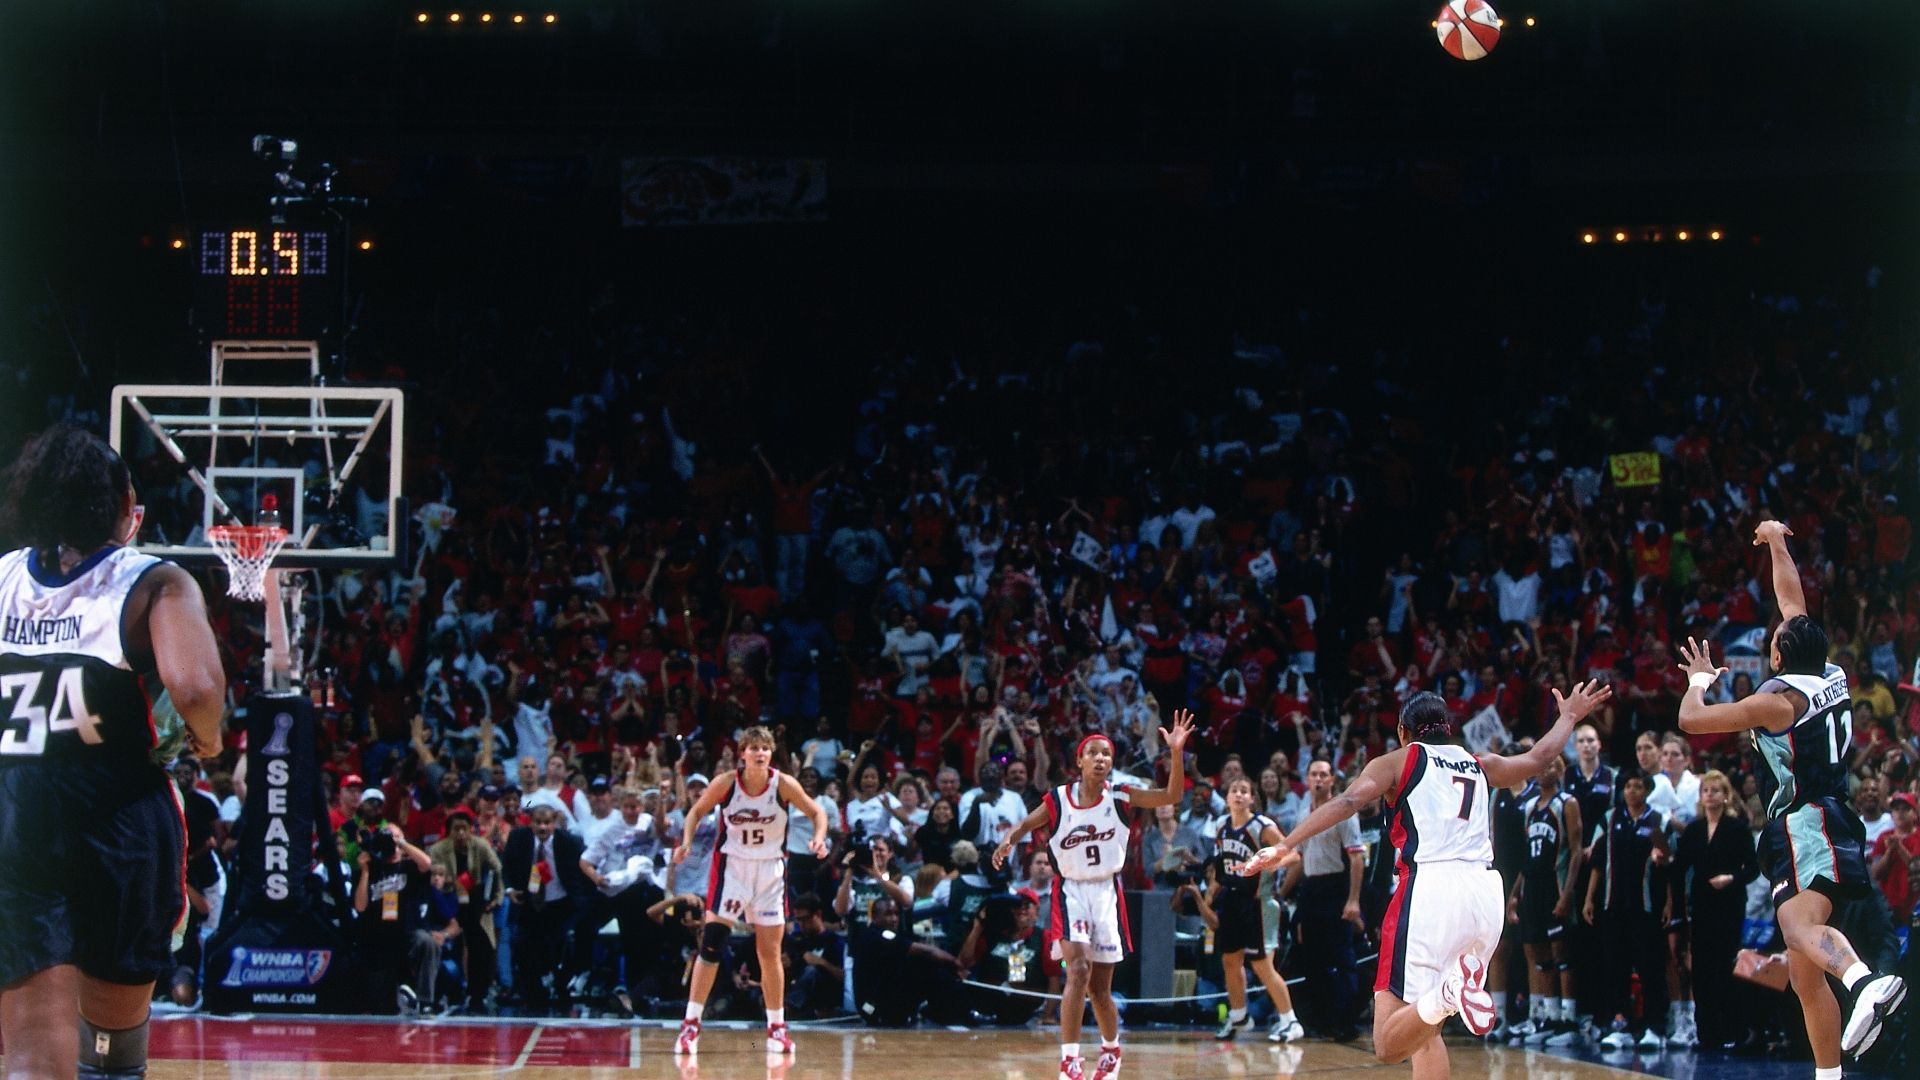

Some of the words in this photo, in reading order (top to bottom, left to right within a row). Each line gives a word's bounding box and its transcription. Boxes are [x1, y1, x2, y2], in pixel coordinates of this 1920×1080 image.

[2, 615, 83, 646] HAMPTON
[0, 667, 104, 755] 34
[1825, 710, 1852, 764] 11
[1452, 776, 1476, 821] 7
[264, 758, 290, 900] SEARS
[742, 829, 764, 845] 15
[1086, 845, 1101, 867] 9
[251, 952, 304, 967] WNBA
[252, 993, 317, 1005] WNBA.COM
